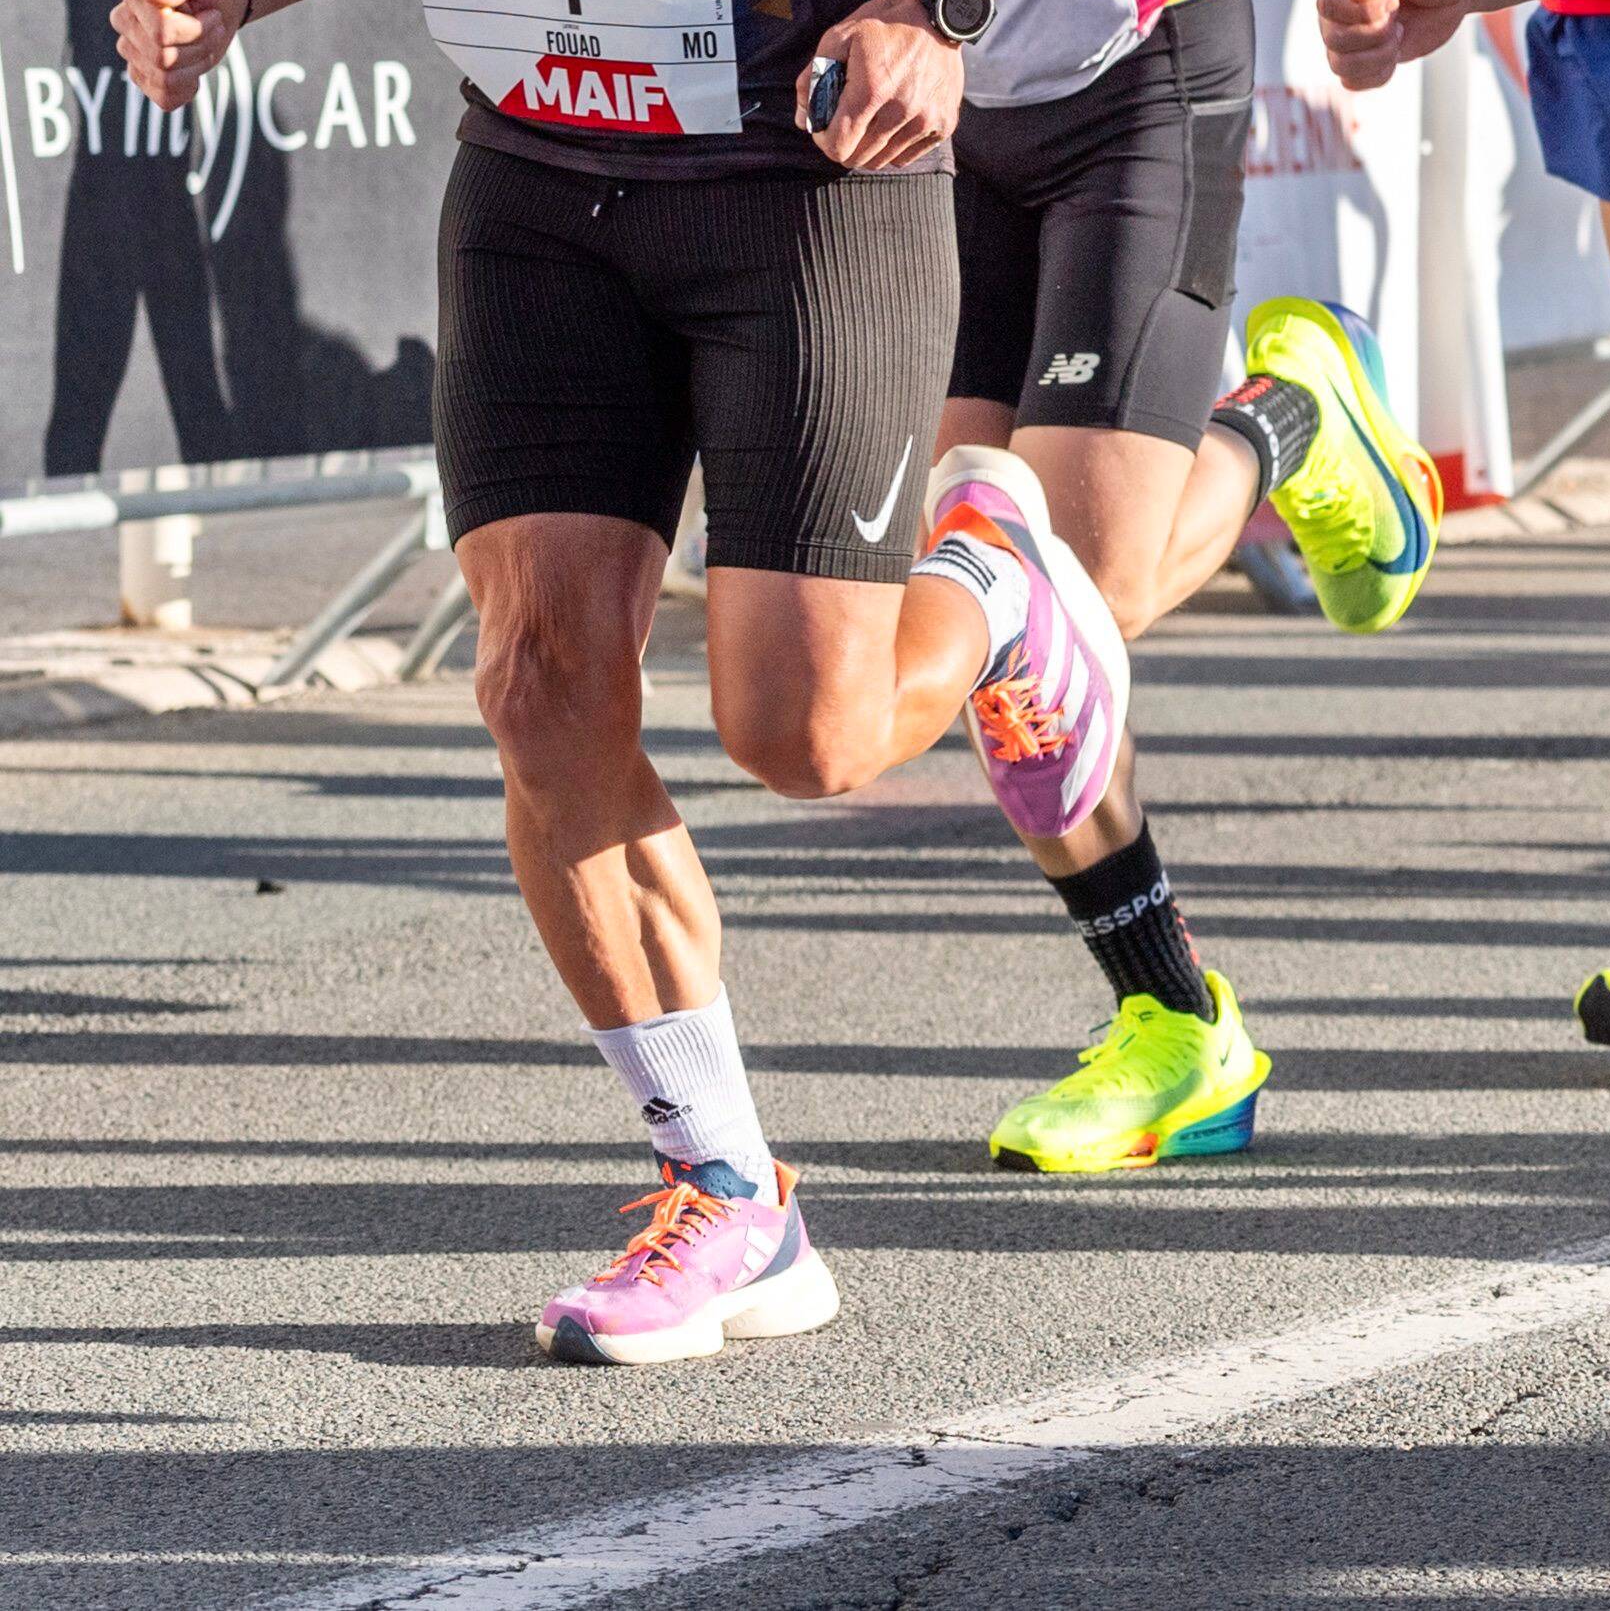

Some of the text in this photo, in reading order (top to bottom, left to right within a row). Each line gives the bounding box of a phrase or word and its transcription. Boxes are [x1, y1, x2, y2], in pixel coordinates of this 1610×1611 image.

[545, 30, 719, 60] FOUAD MO
[520, 66, 665, 123] MAIF
